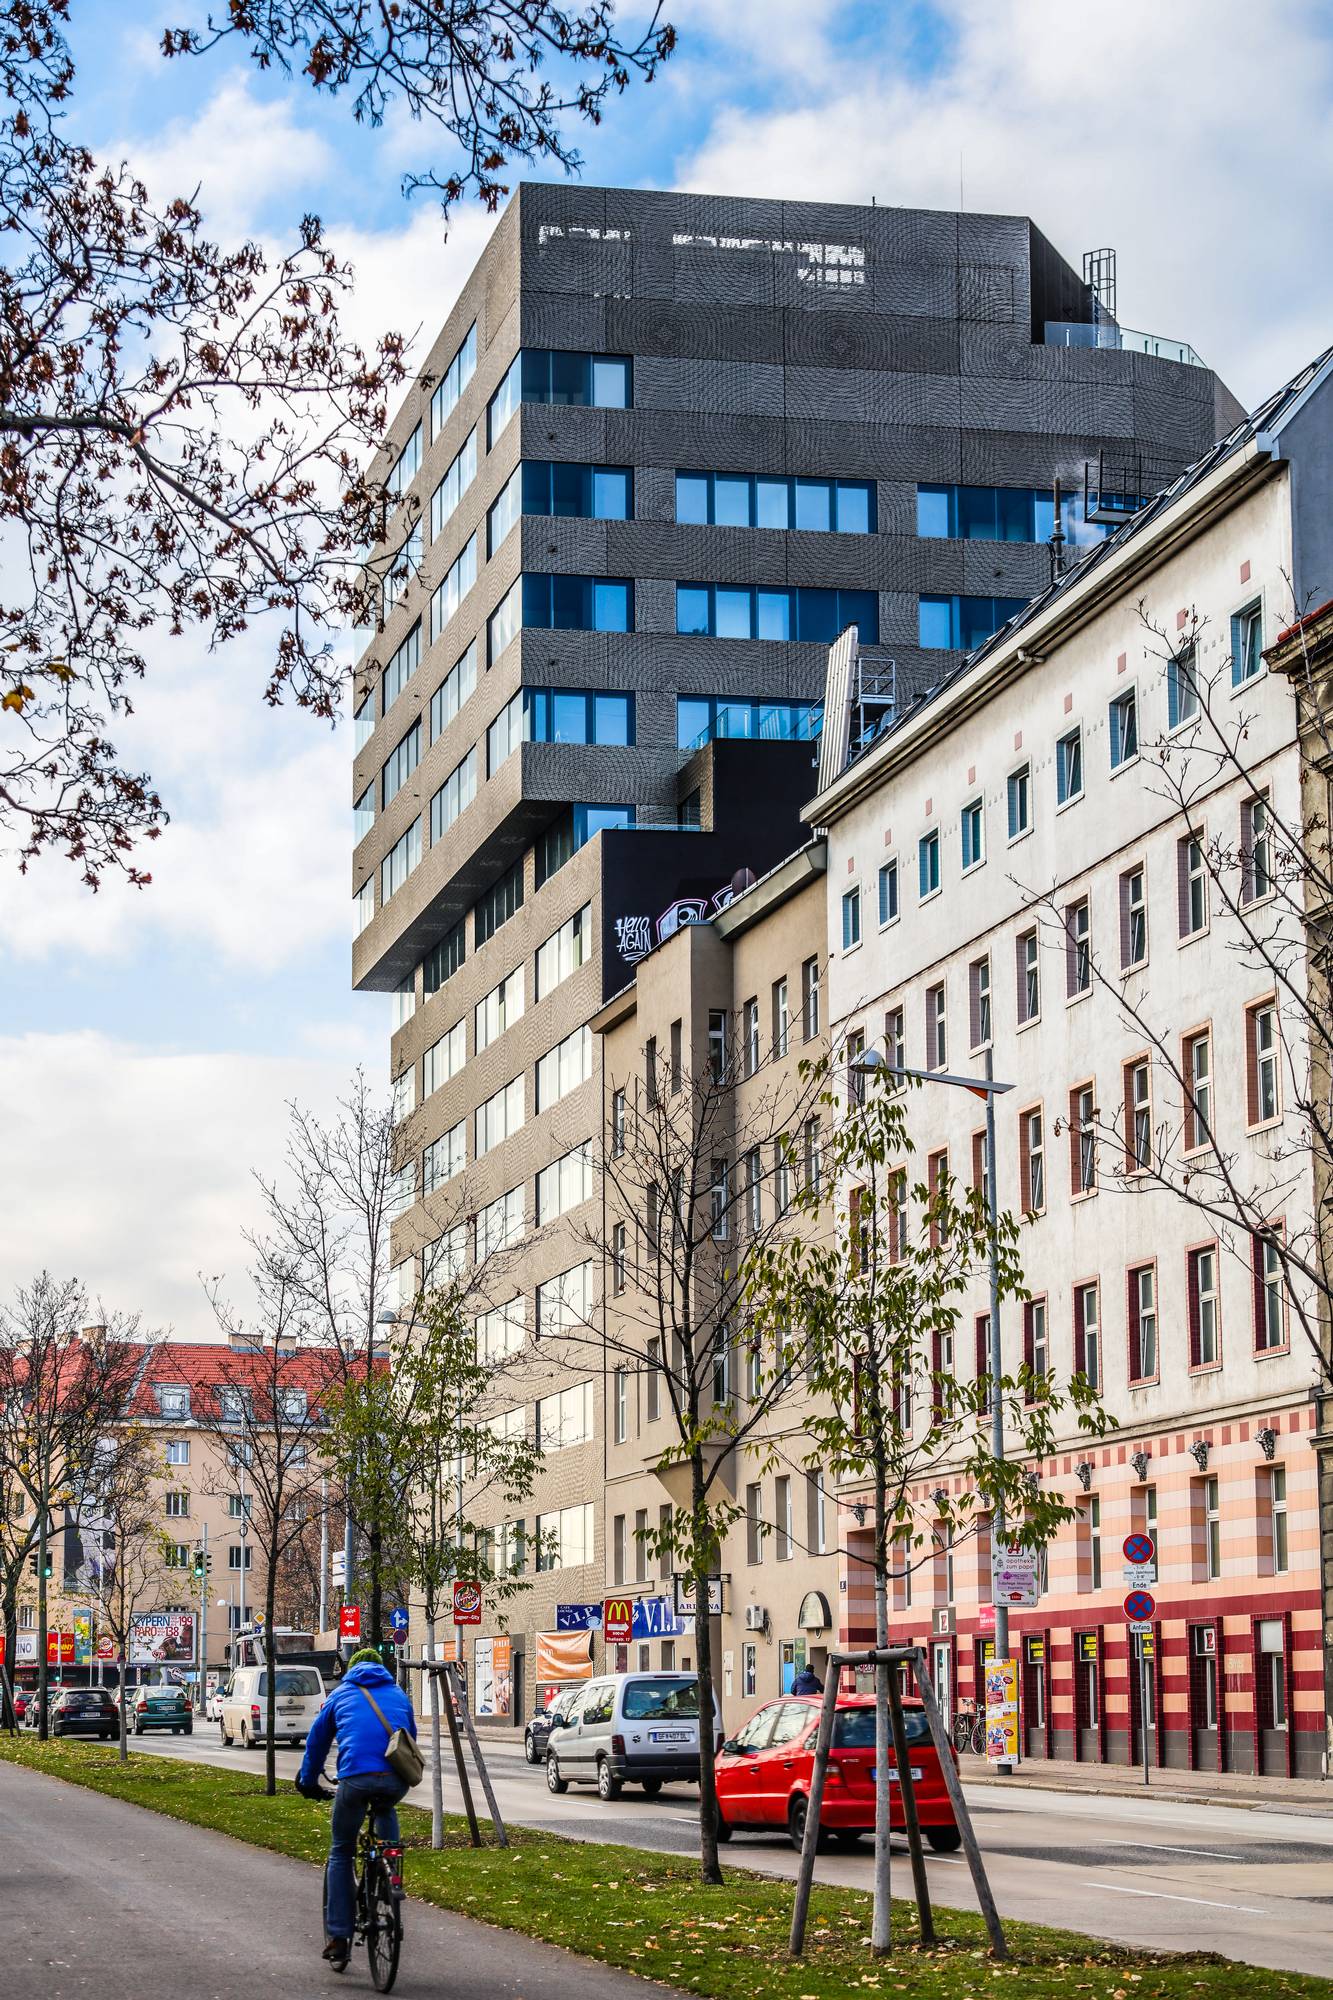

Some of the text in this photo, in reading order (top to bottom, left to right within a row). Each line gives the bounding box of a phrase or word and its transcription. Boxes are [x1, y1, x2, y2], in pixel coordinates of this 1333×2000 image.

[179, 1616, 193, 1627] 199
[135, 1626, 157, 1637] FARO
[165, 1626, 179, 1637] 138
[1132, 1624, 1151, 1632] Anfang
[16, 1642, 33, 1654] INO
